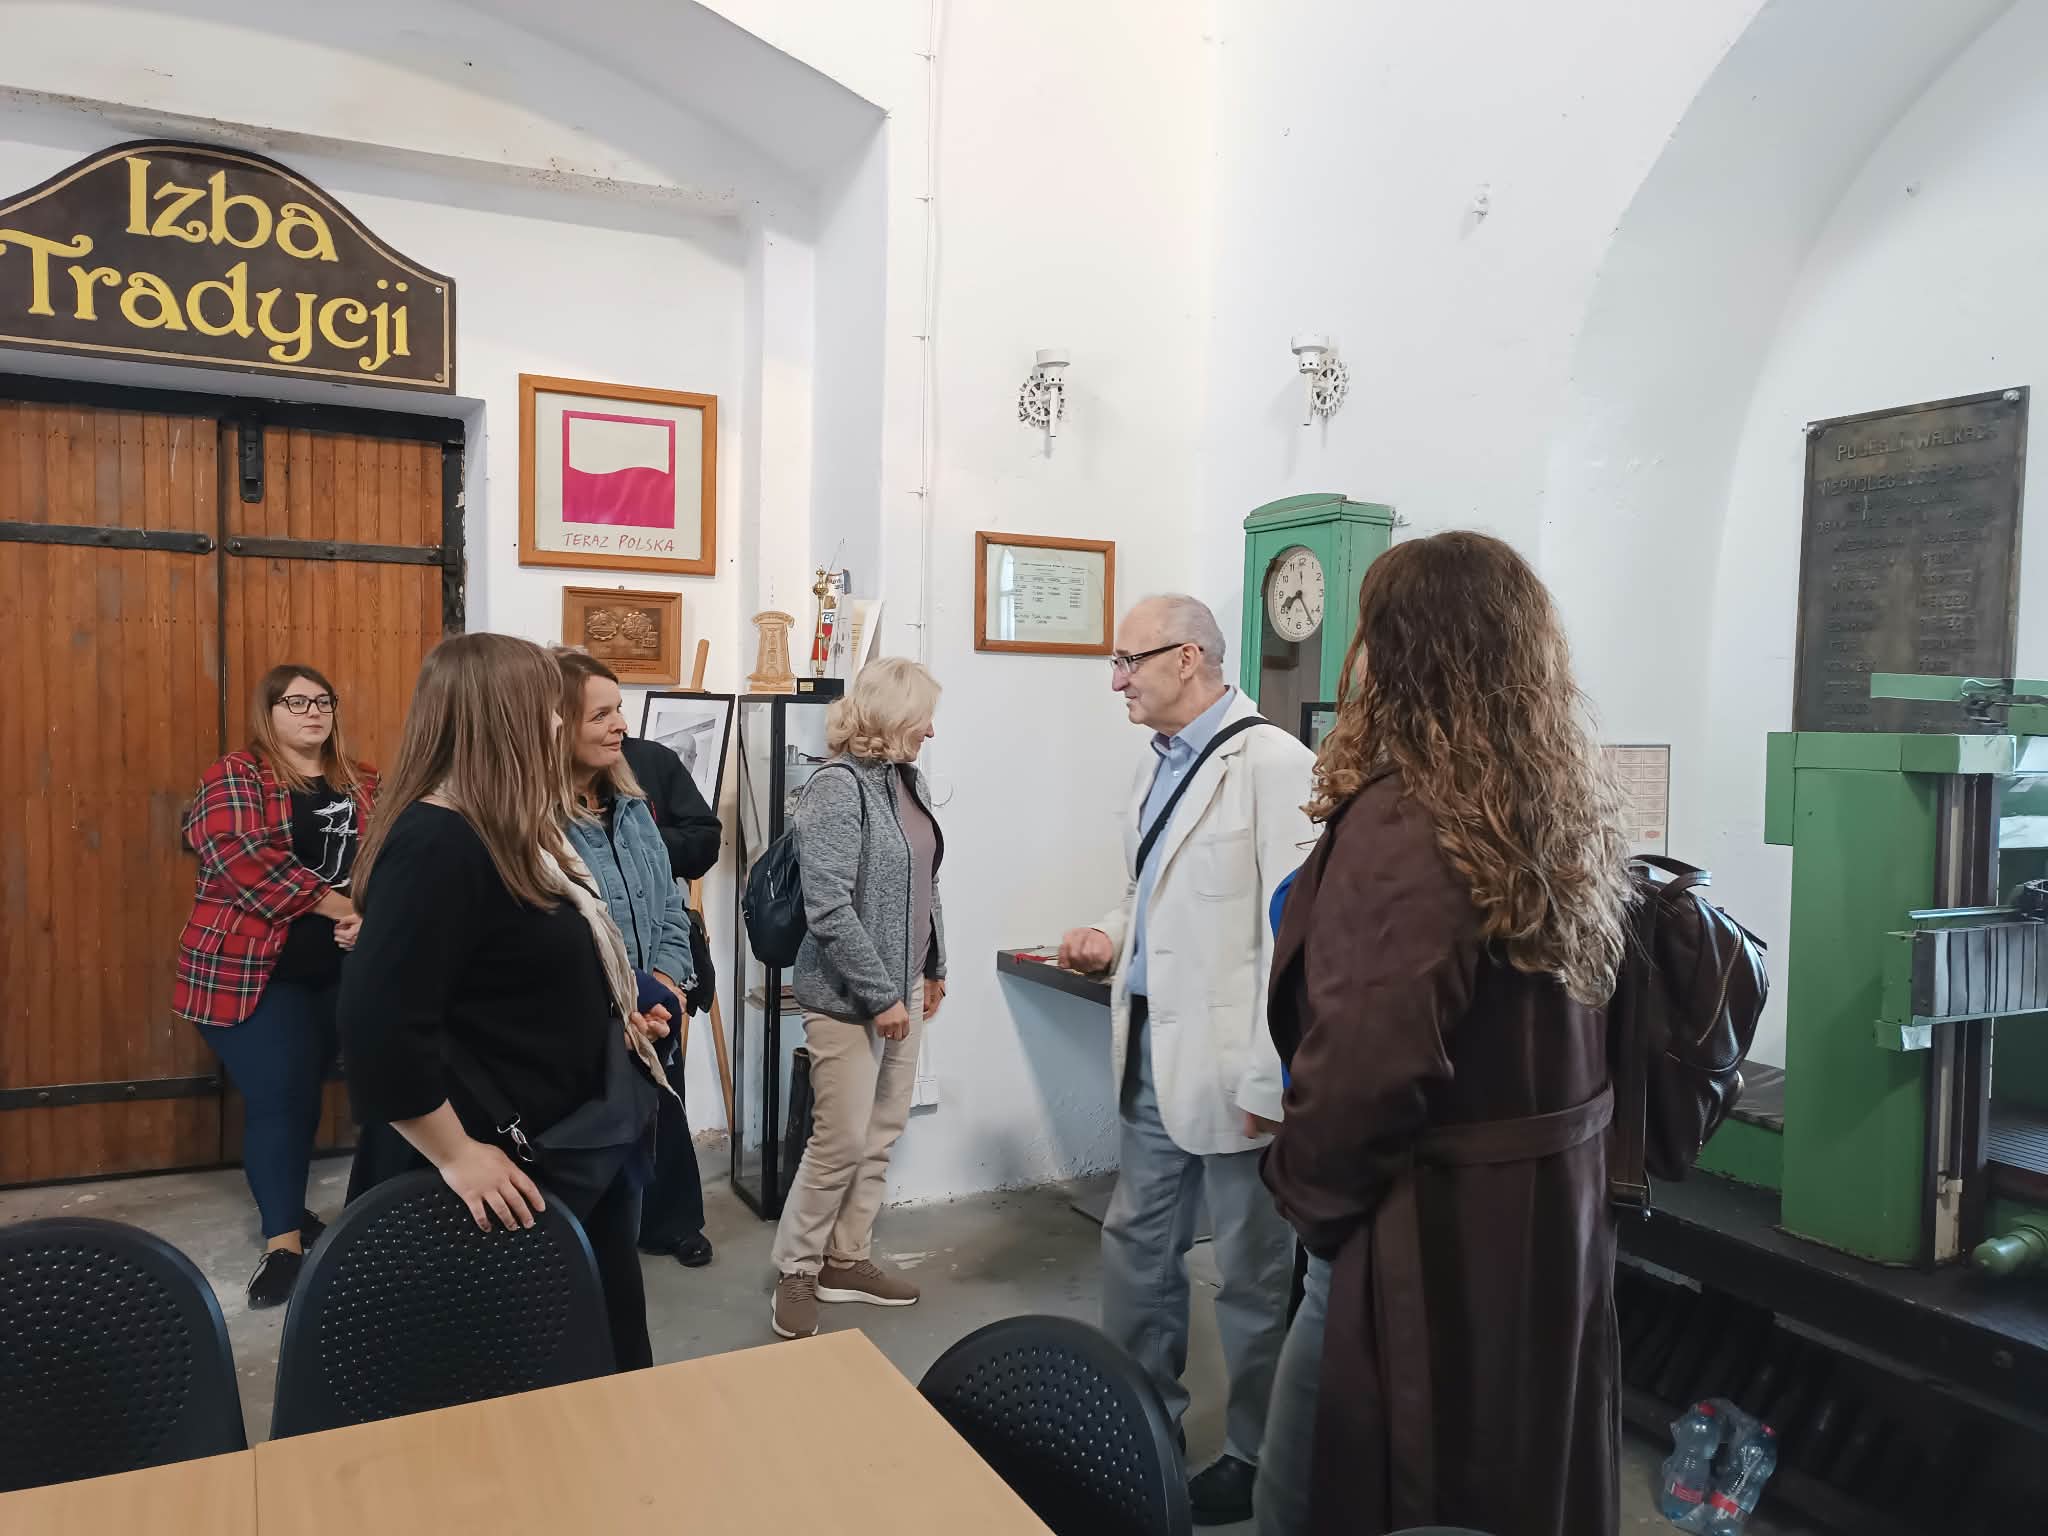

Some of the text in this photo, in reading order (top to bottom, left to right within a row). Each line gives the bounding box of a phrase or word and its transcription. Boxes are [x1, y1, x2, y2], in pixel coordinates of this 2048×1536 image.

[125, 156, 339, 262] Izba
[0, 228, 411, 371] Tradycji
[563, 533, 675, 552] TERAZ POLSKA
